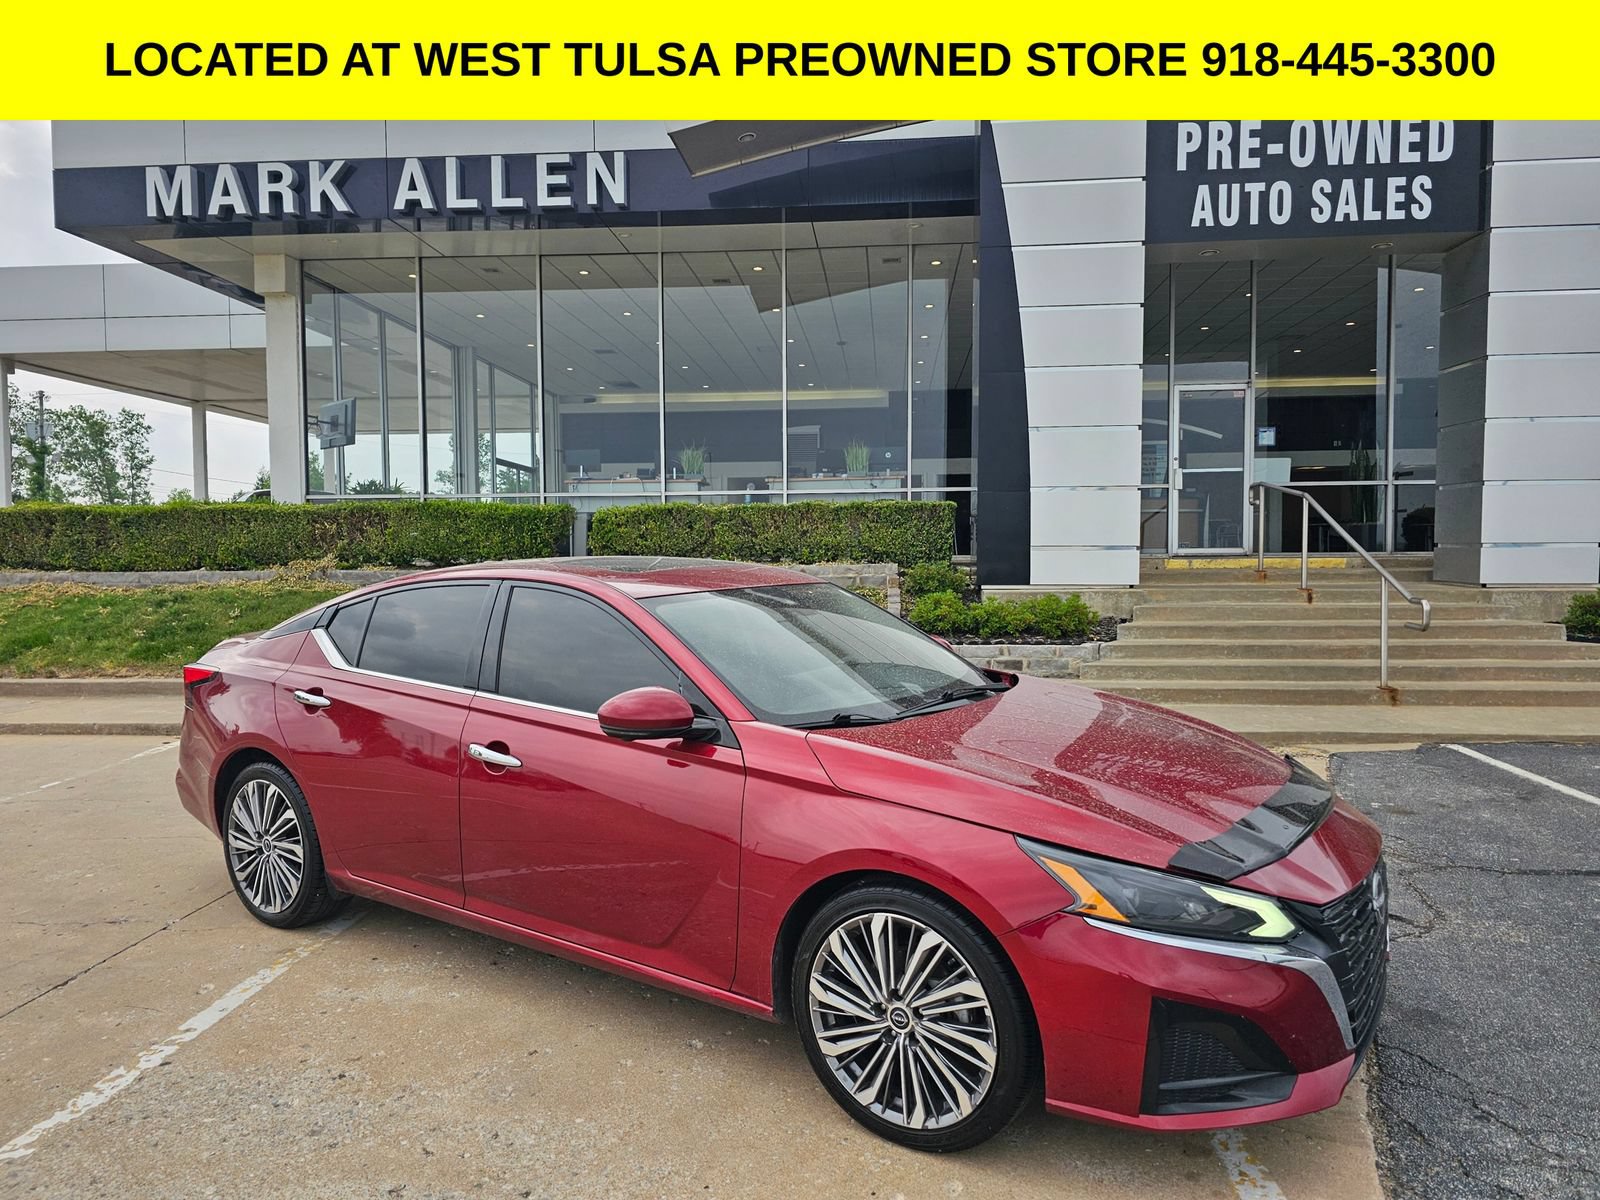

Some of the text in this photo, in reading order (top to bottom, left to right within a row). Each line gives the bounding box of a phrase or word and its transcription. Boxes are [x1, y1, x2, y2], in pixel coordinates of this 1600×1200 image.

[1176, 119, 1454, 171] PRE-OWNED
[145, 151, 627, 217] MARK ALLEN
[1190, 175, 1433, 227] AUTO SALES
